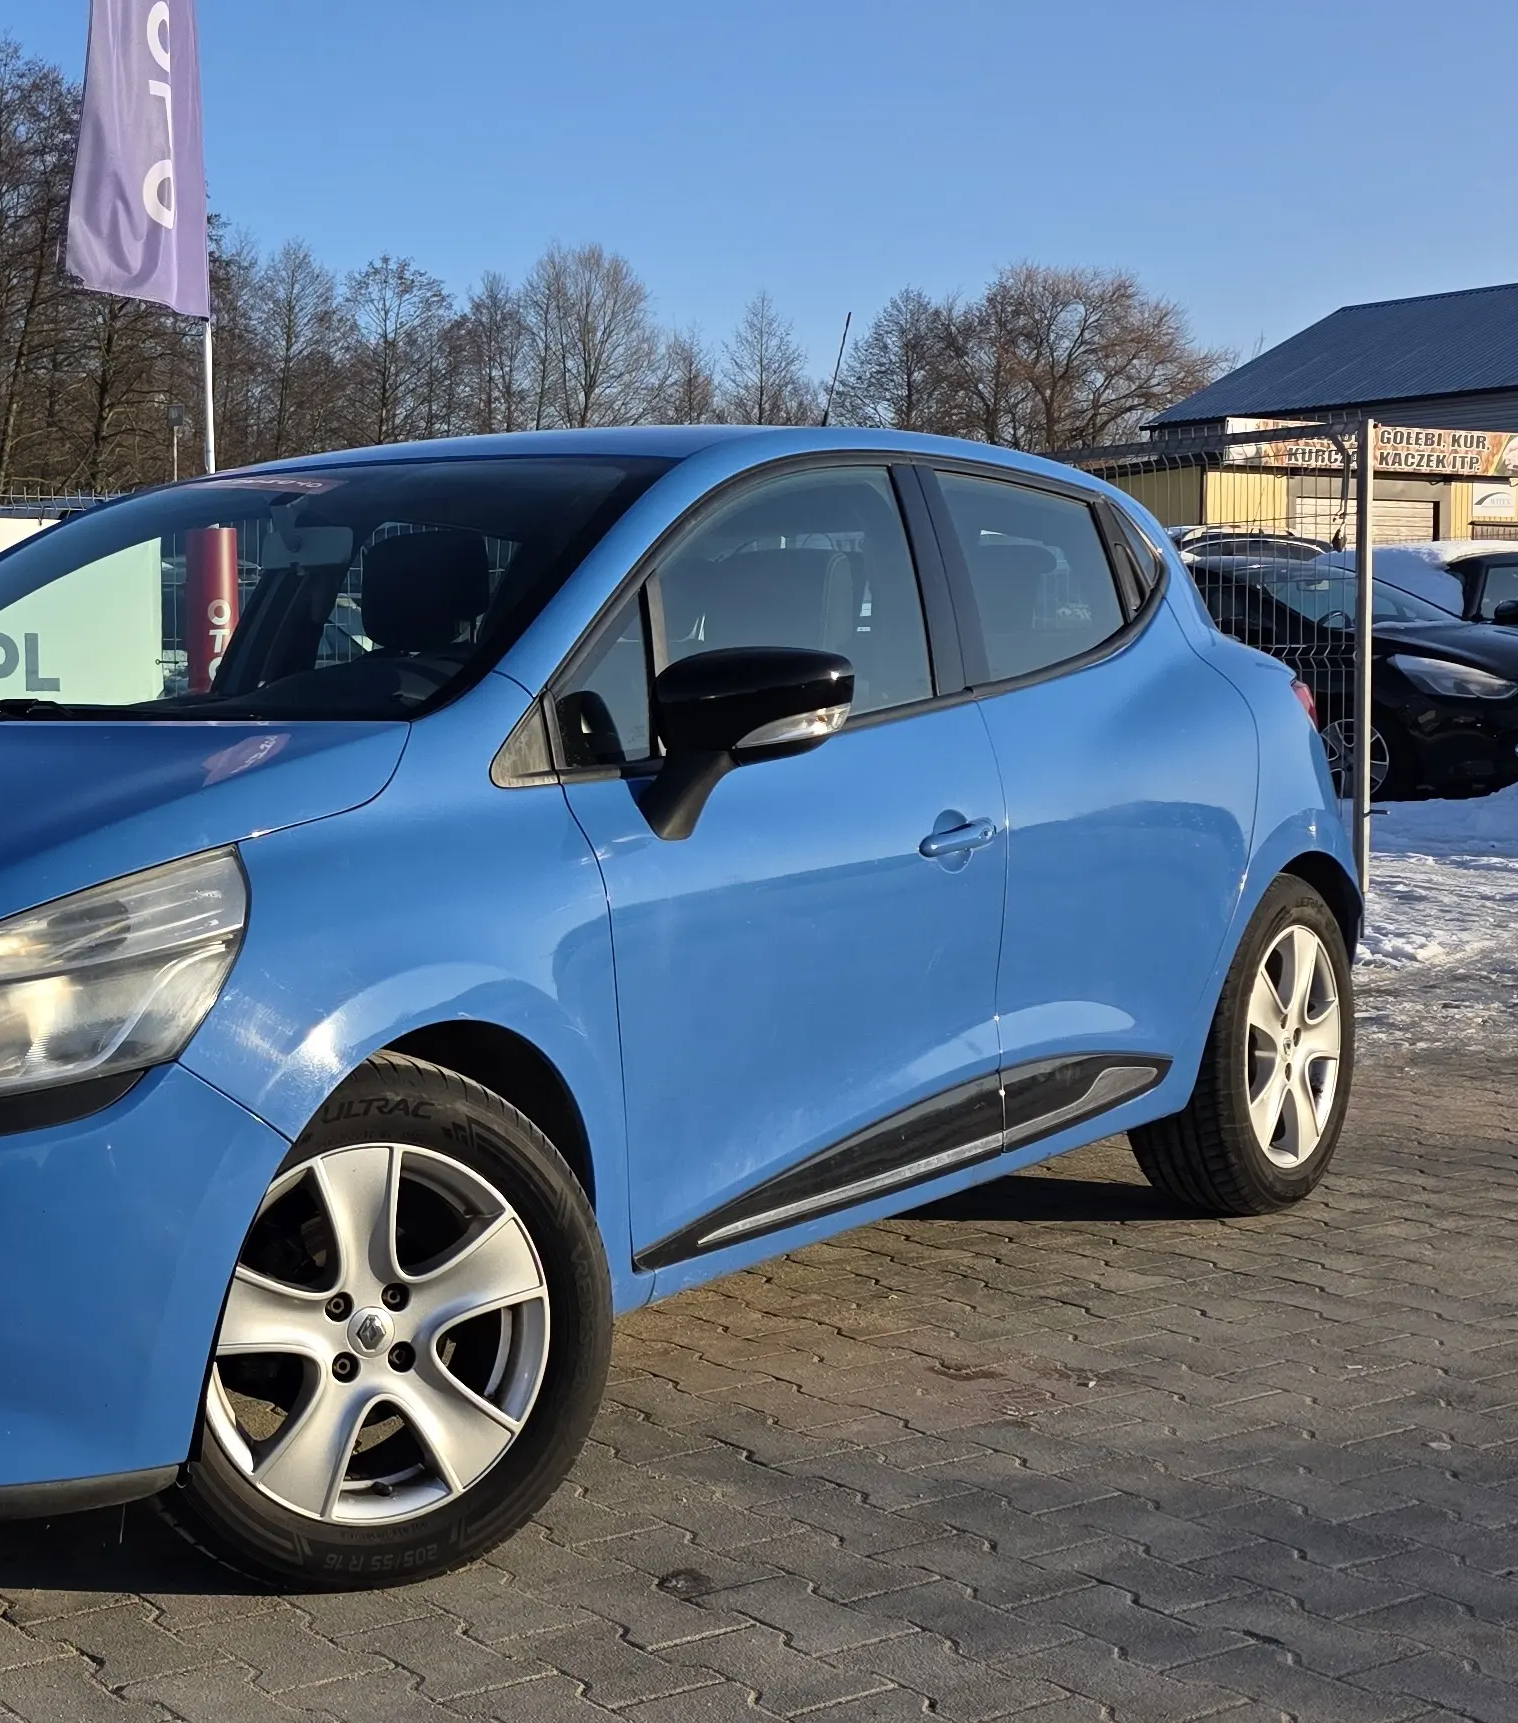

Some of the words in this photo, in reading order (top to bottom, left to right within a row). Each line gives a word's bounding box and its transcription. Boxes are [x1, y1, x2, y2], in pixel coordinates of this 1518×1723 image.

[1380, 430, 1446, 448] GOŁĘBI,
[1378, 451, 1447, 468] KACZEK
[1451, 455, 1480, 471] ITP.
[322, 1098, 435, 1123] ULTRAC
[323, 1553, 344, 1571] 16
[348, 1553, 364, 1571] R
[370, 1544, 438, 1571] 205/55
